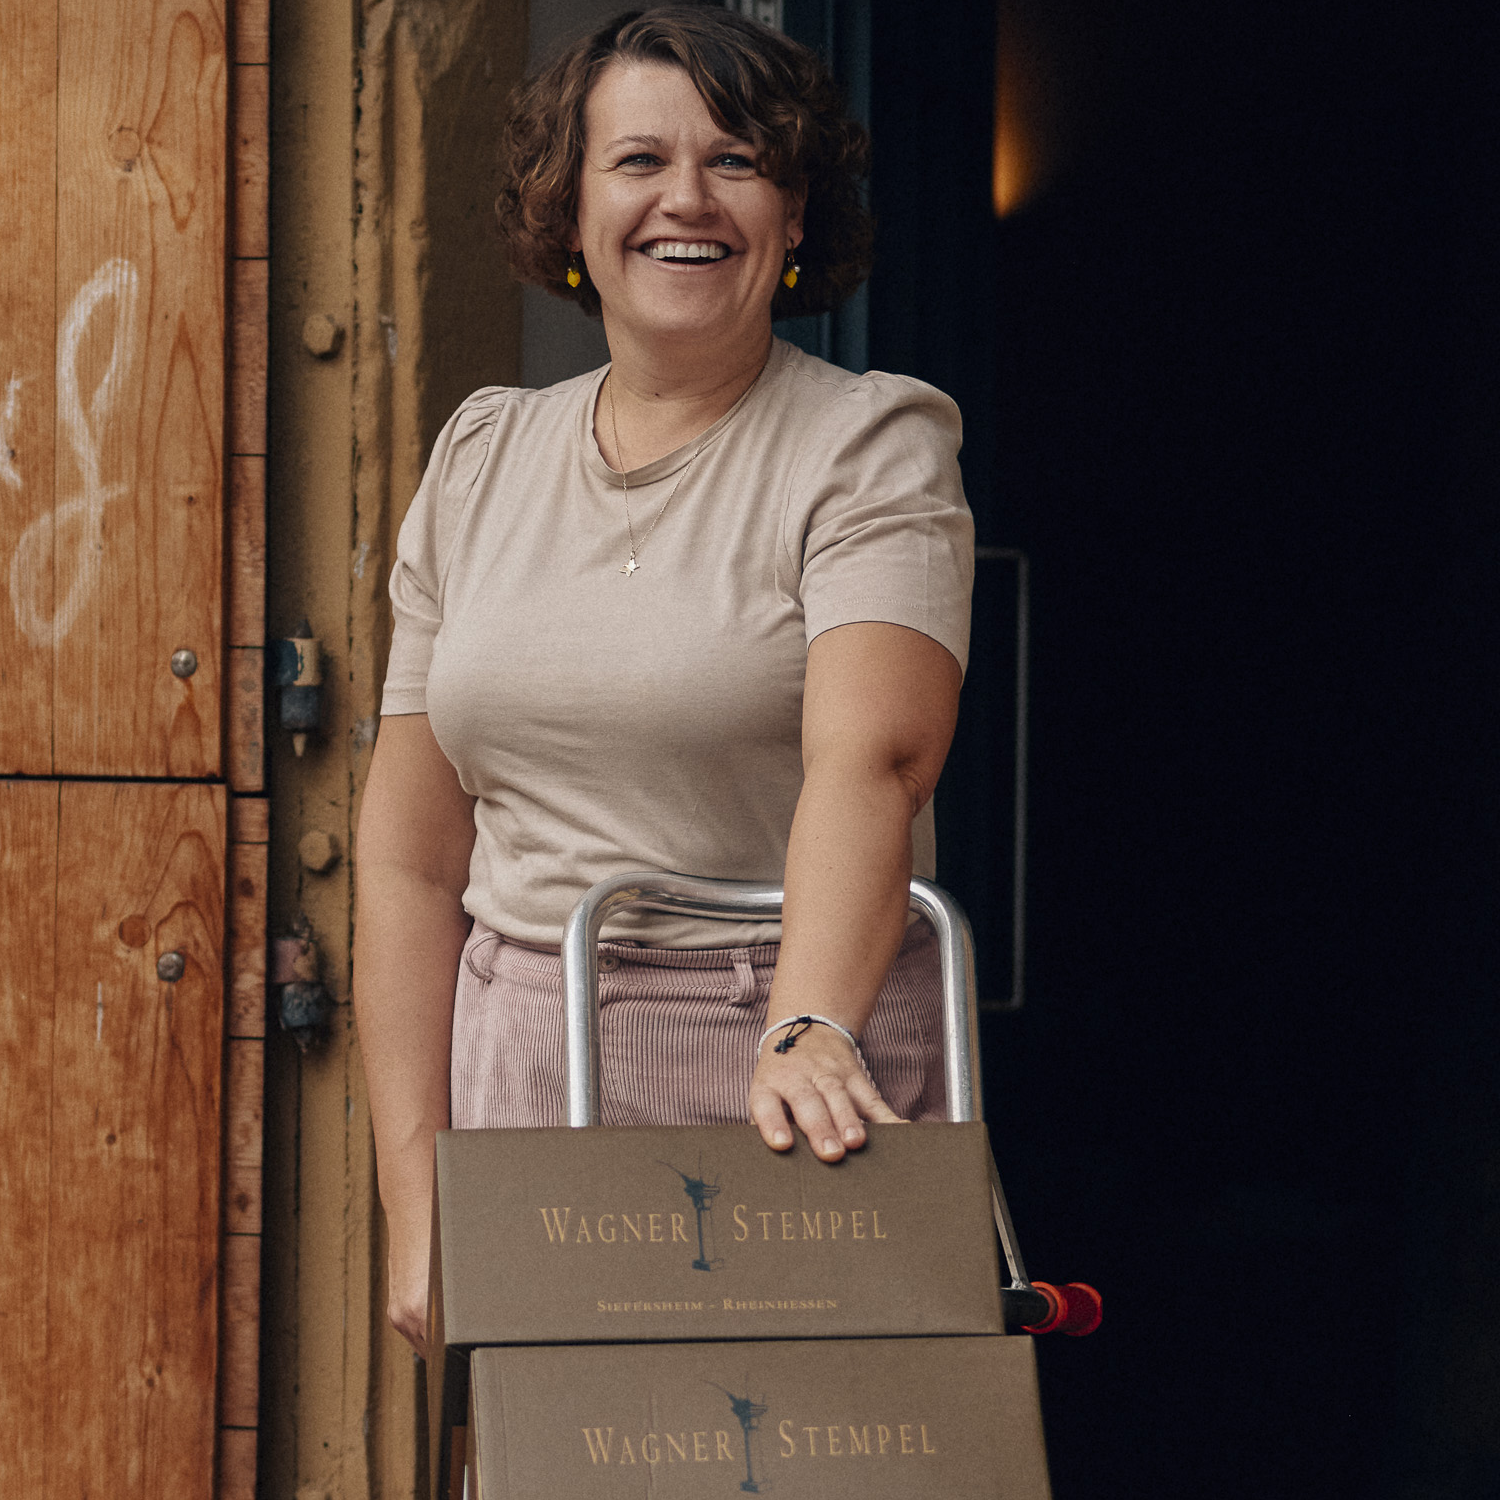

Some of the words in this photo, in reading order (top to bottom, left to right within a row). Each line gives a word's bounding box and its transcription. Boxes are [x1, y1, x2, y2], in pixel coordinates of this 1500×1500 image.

[539, 1205, 690, 1245] WAGNER
[732, 1204, 888, 1242] STEMPEL
[596, 1299, 704, 1313] SIEFERSHEIM
[722, 1297, 839, 1311] RHEINHESSEN
[581, 1426, 735, 1466] WAGNER
[778, 1420, 937, 1459] STEMPEL
